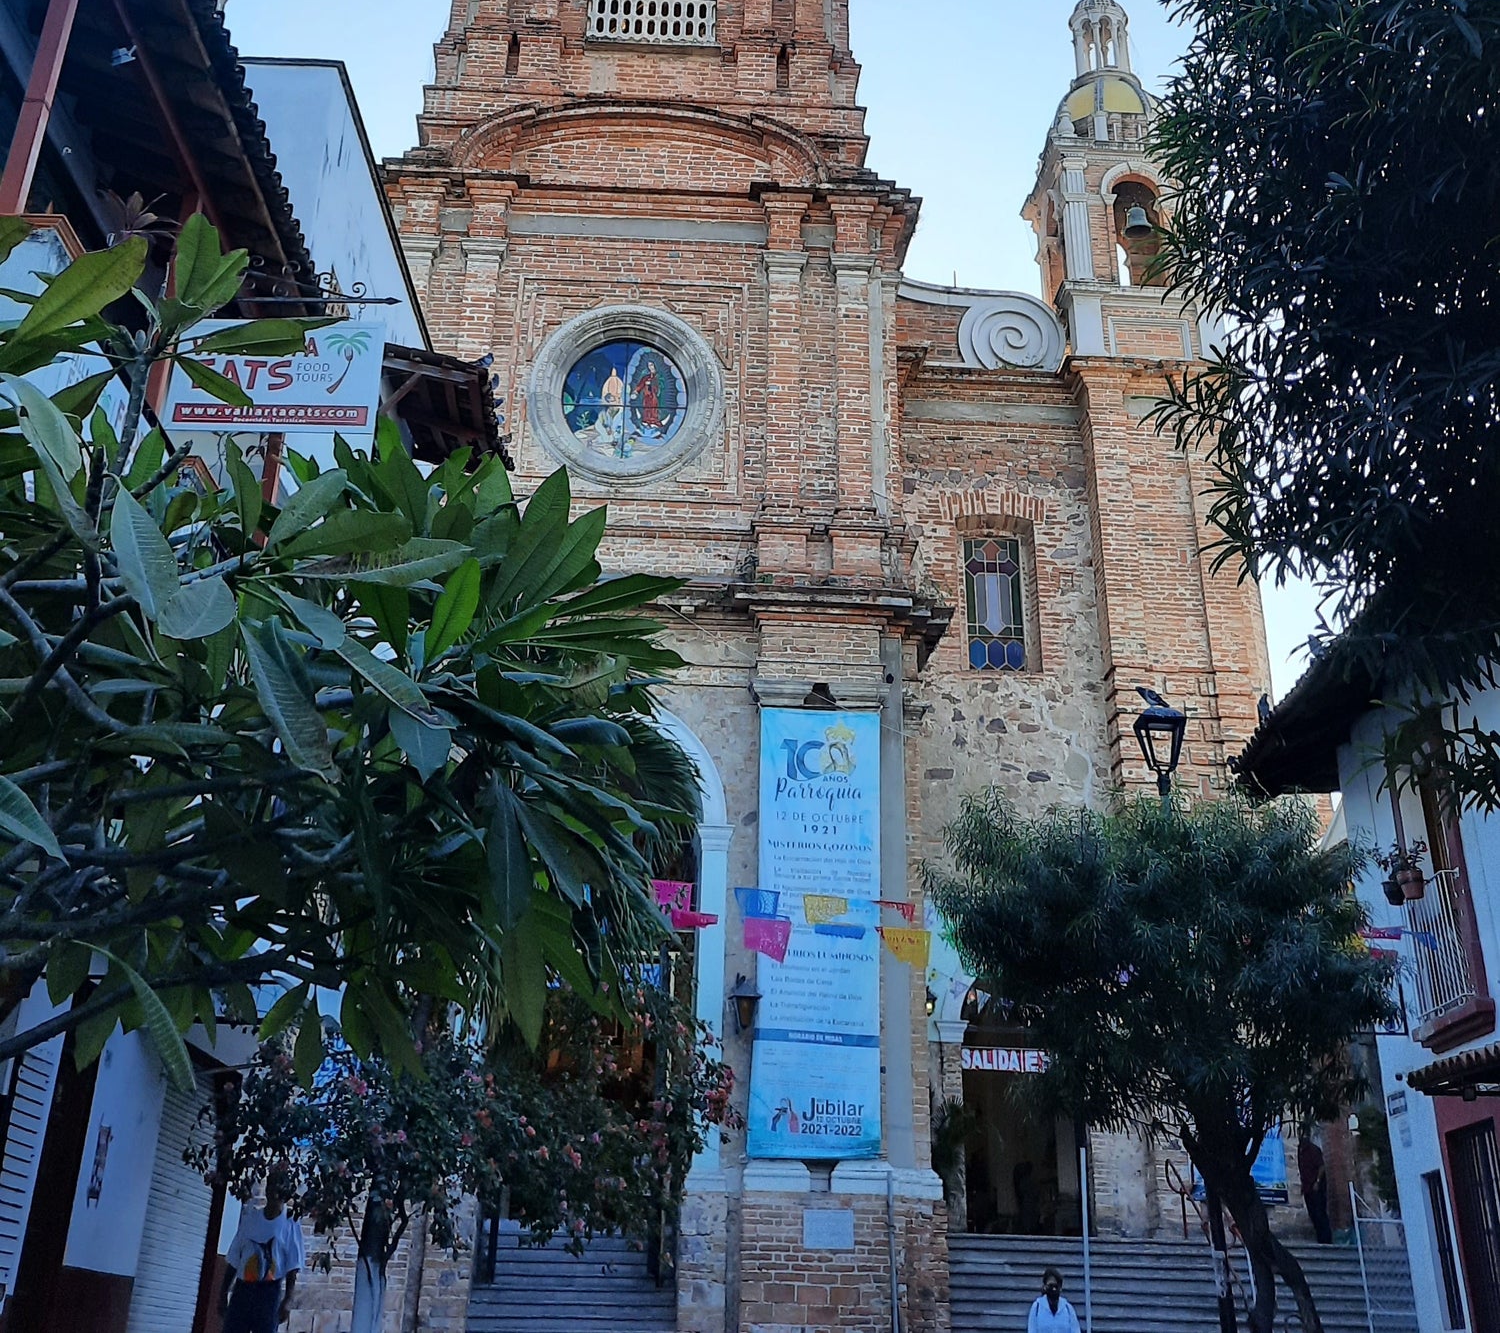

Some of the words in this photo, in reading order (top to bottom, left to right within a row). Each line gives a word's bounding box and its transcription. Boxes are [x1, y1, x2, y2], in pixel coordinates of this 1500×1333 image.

[297, 362, 330, 372] FOOD
[296, 372, 333, 382] TOURS
[822, 775, 848, 784] AÑOS
[775, 777, 862, 811] Parroquia
[776, 811, 786, 821] 12
[793, 812, 804, 822] DE
[812, 813, 864, 824] OCTUBRE
[803, 825, 837, 834] 1921
[768, 839, 821, 850] MISTERIOS
[823, 842, 872, 852] GOZOSOS
[787, 949, 816, 958] ERIOS
[817, 950, 874, 962] LUMINOSOS
[961, 1048, 1020, 1072] SALIDA
[802, 1098, 864, 1121] Jubilar
[801, 1124, 862, 1136] 2021-2022
